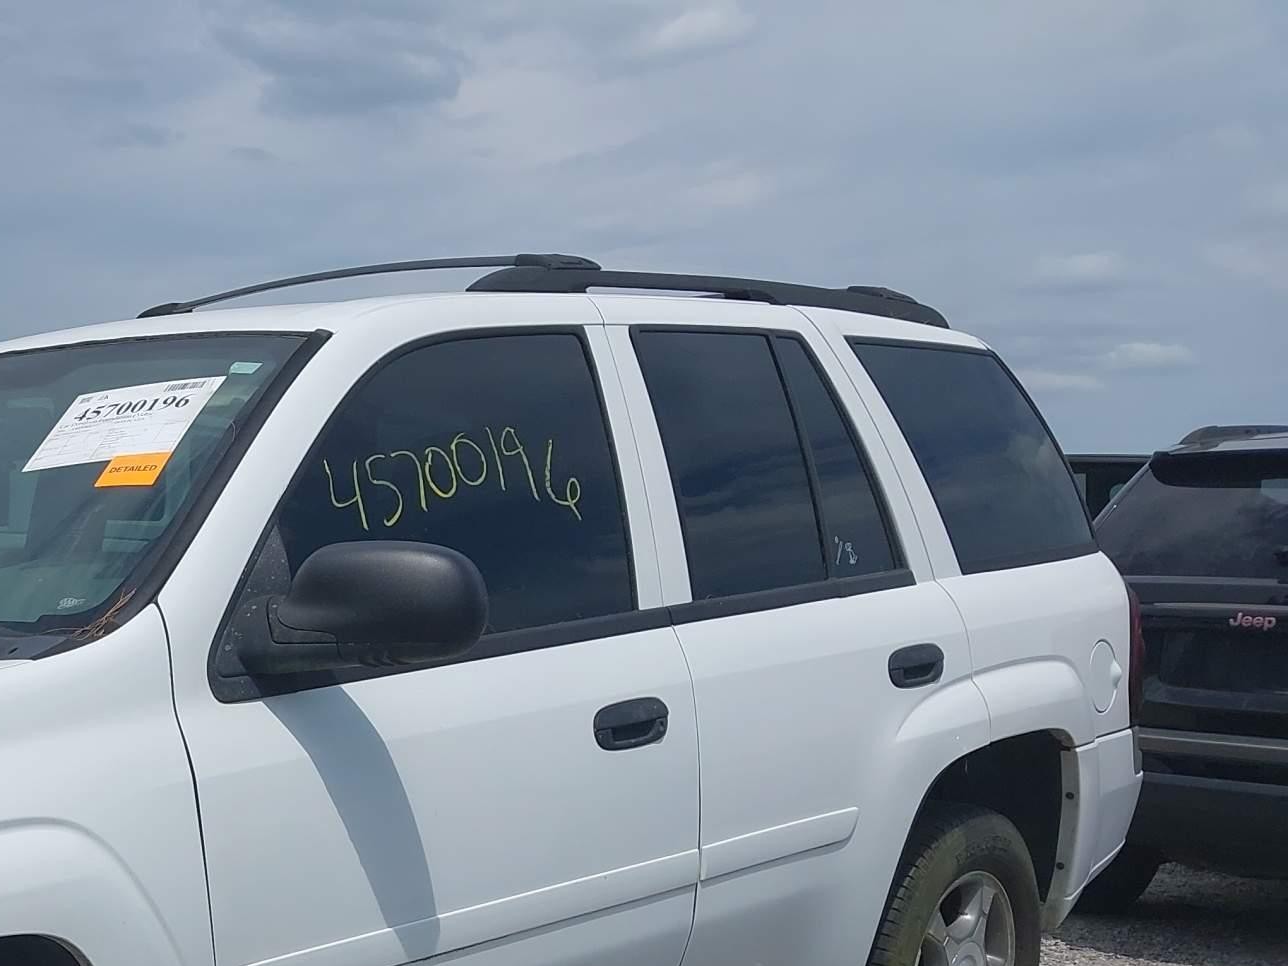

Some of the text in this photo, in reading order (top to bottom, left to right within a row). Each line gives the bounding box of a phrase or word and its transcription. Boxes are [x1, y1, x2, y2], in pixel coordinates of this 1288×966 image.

[73, 393, 192, 422] 45700196
[108, 464, 158, 473] DETAILED
[322, 426, 583, 532] 45700196
[1229, 612, 1277, 631] Jeep
